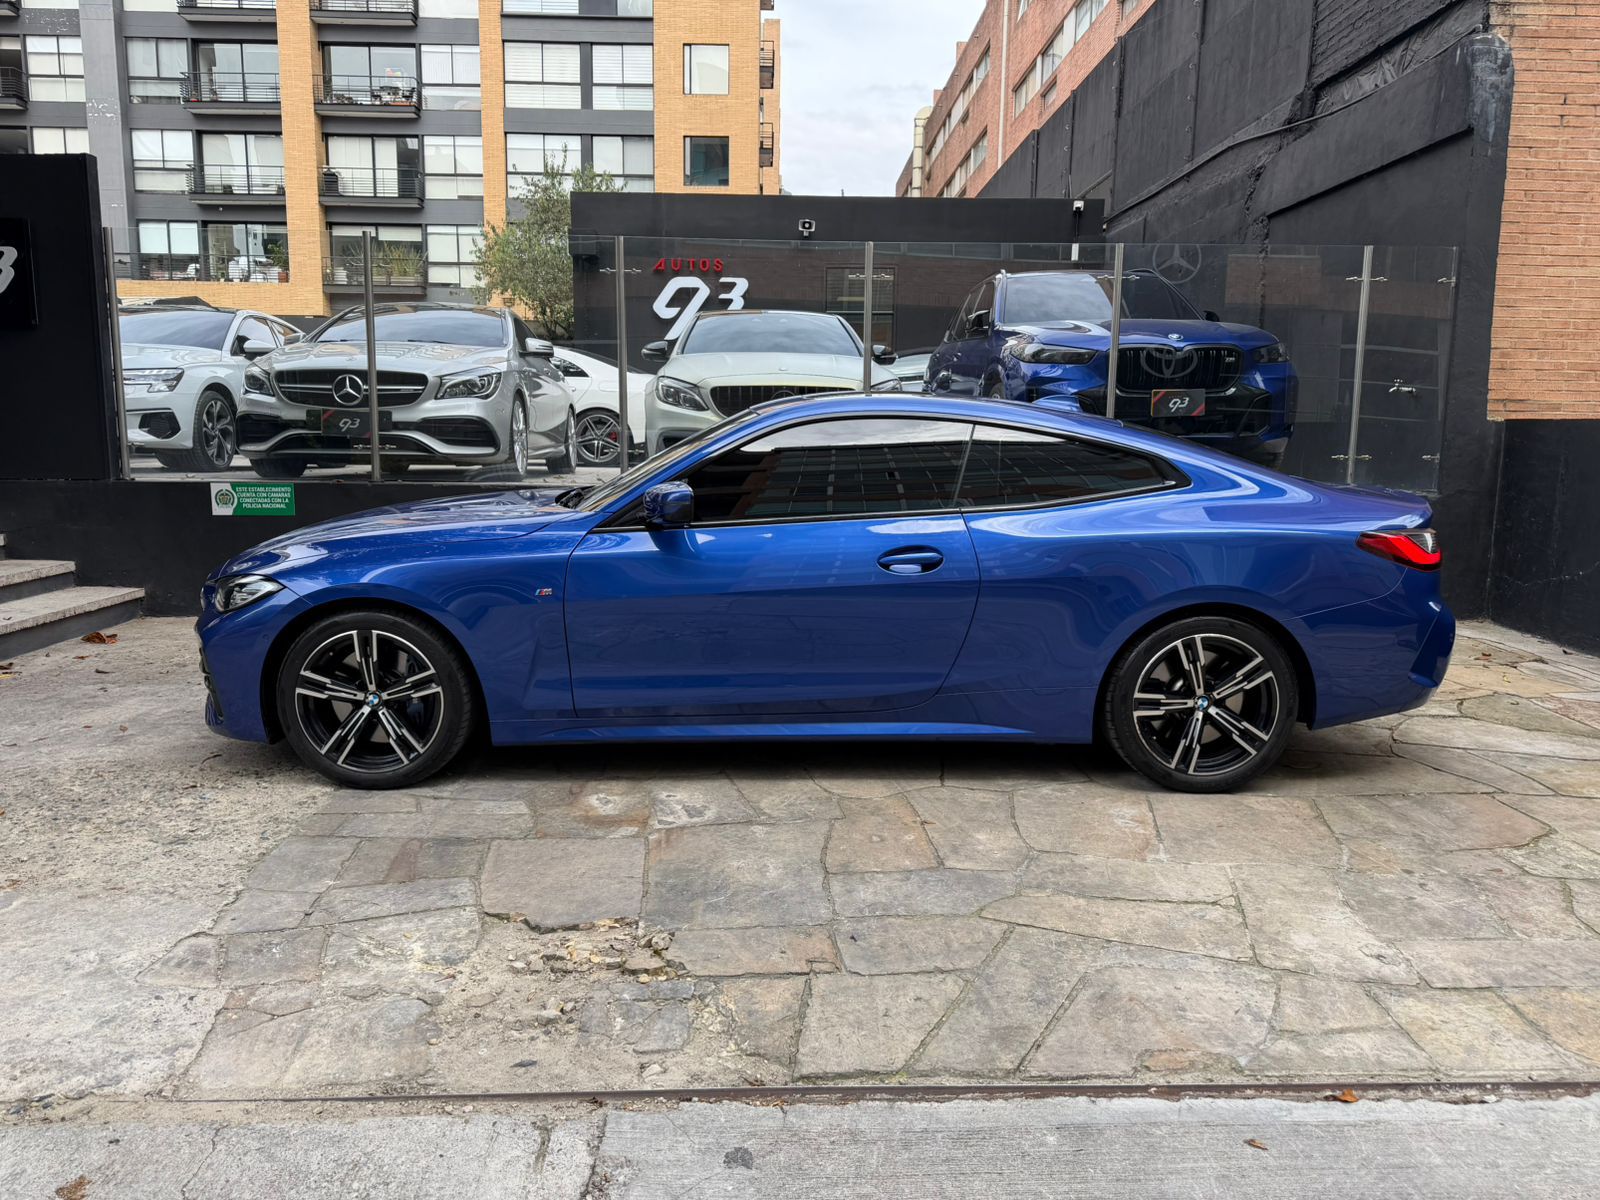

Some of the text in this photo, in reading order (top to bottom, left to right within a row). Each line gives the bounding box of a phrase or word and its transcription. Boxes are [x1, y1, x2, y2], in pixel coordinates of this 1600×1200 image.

[653, 258, 724, 272] AUTOS
[652, 276, 749, 340] 93
[1168, 397, 1189, 412] 93
[339, 418, 360, 432] 93
